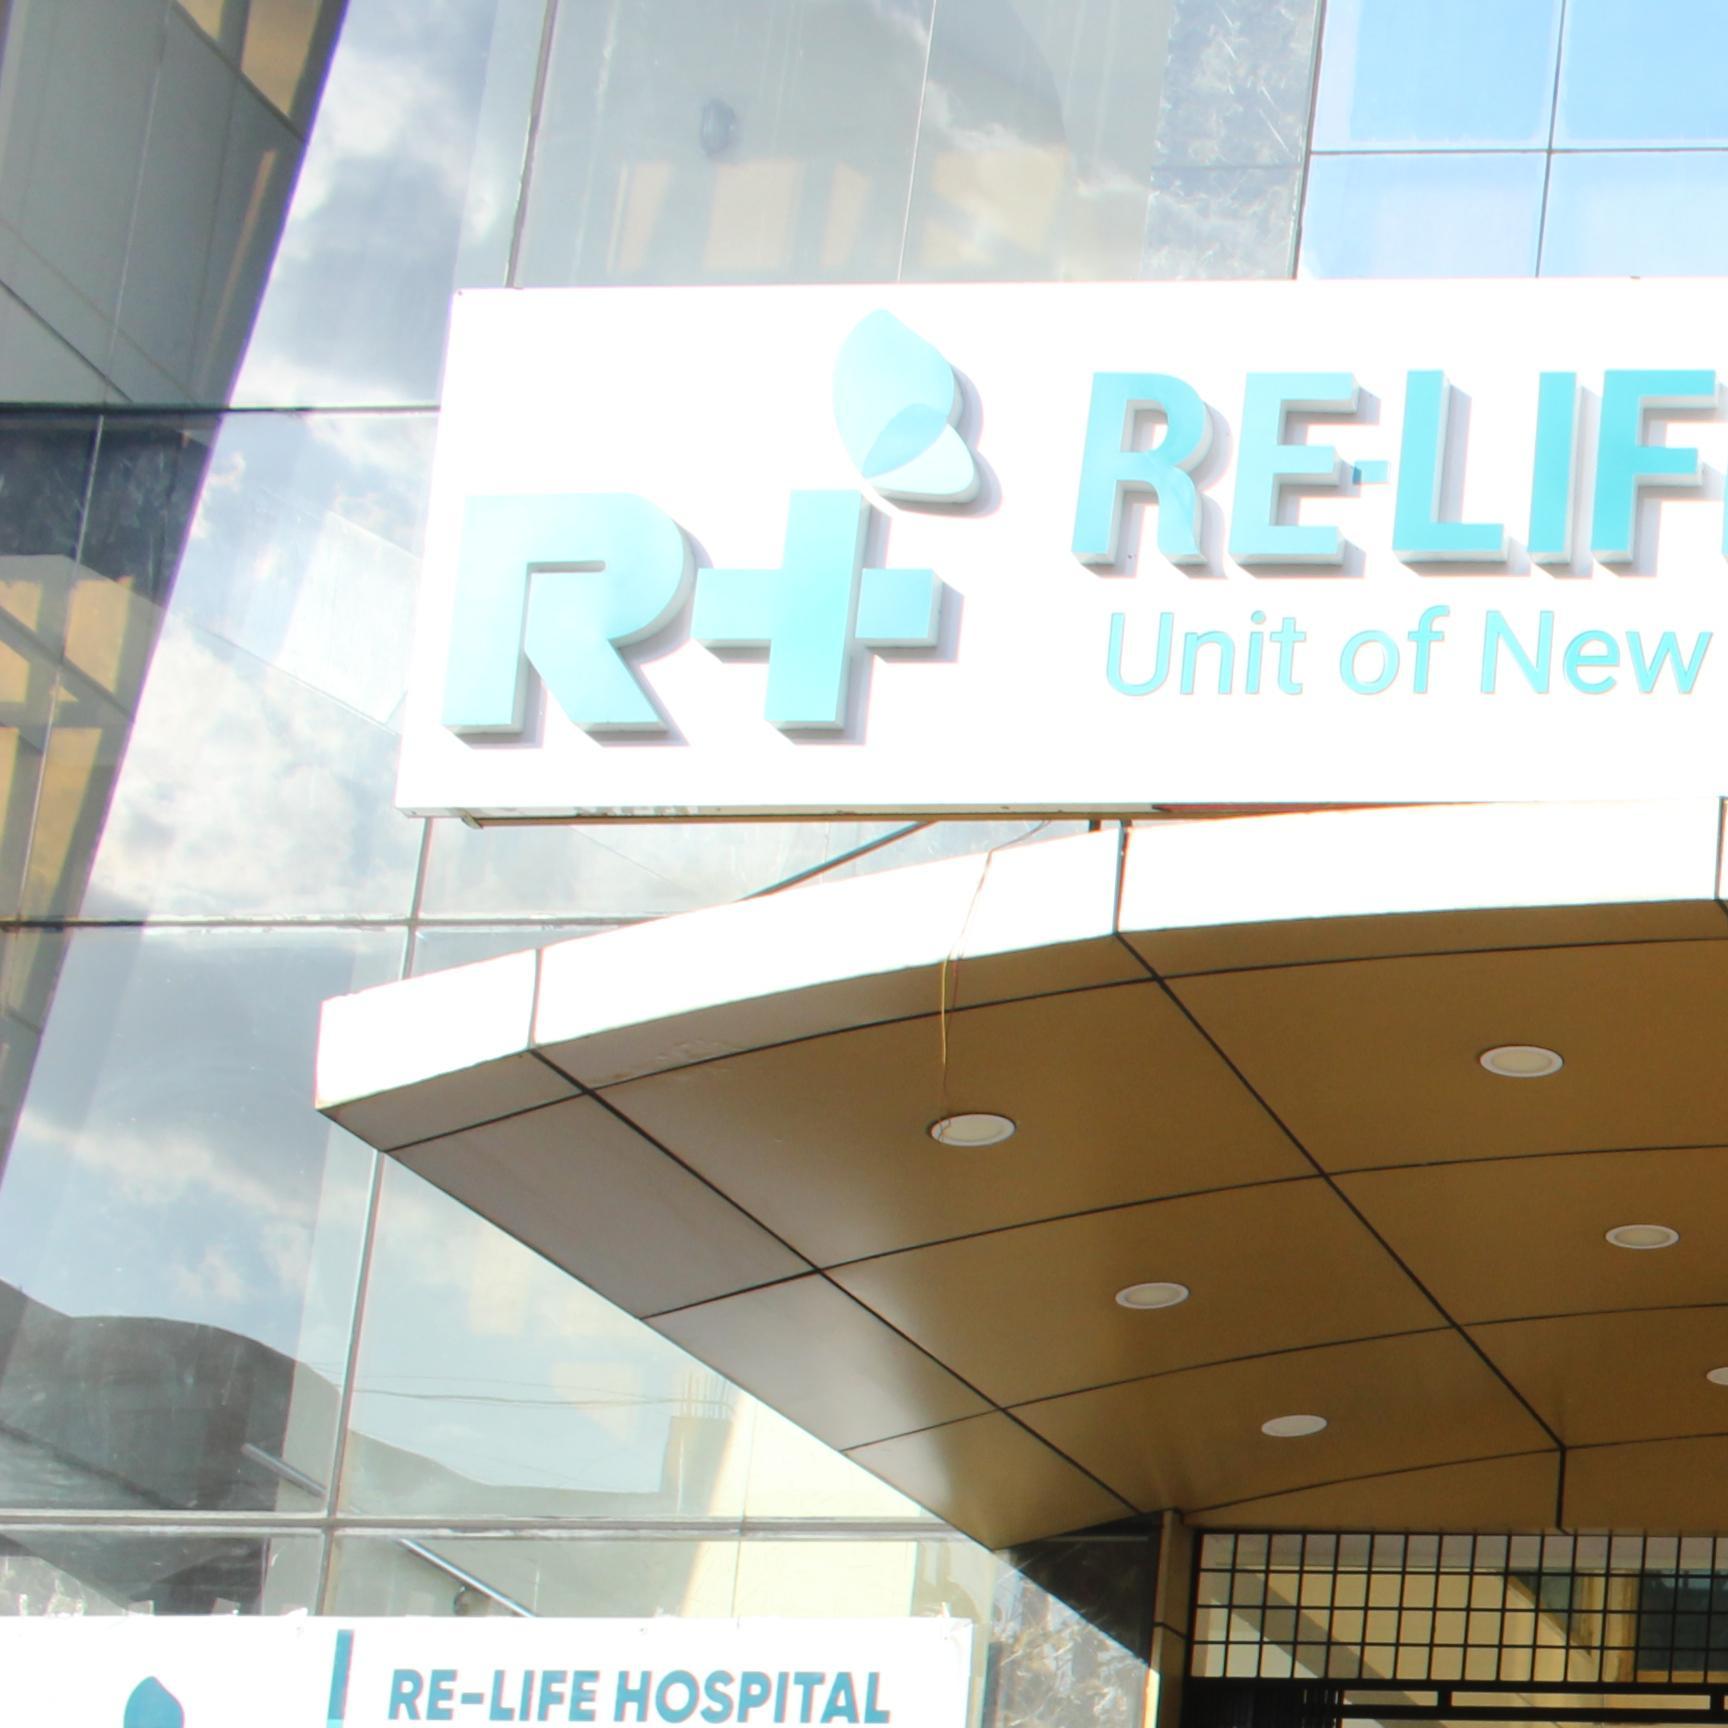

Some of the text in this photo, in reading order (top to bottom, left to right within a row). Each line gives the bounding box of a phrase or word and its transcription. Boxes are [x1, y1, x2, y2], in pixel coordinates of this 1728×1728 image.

[1106, 608, 1306, 697] Unit
[1340, 603, 1451, 696] of
[1481, 608, 1713, 697] New
[387, 1668, 893, 1727] RE-LIFE HOSPITAL
